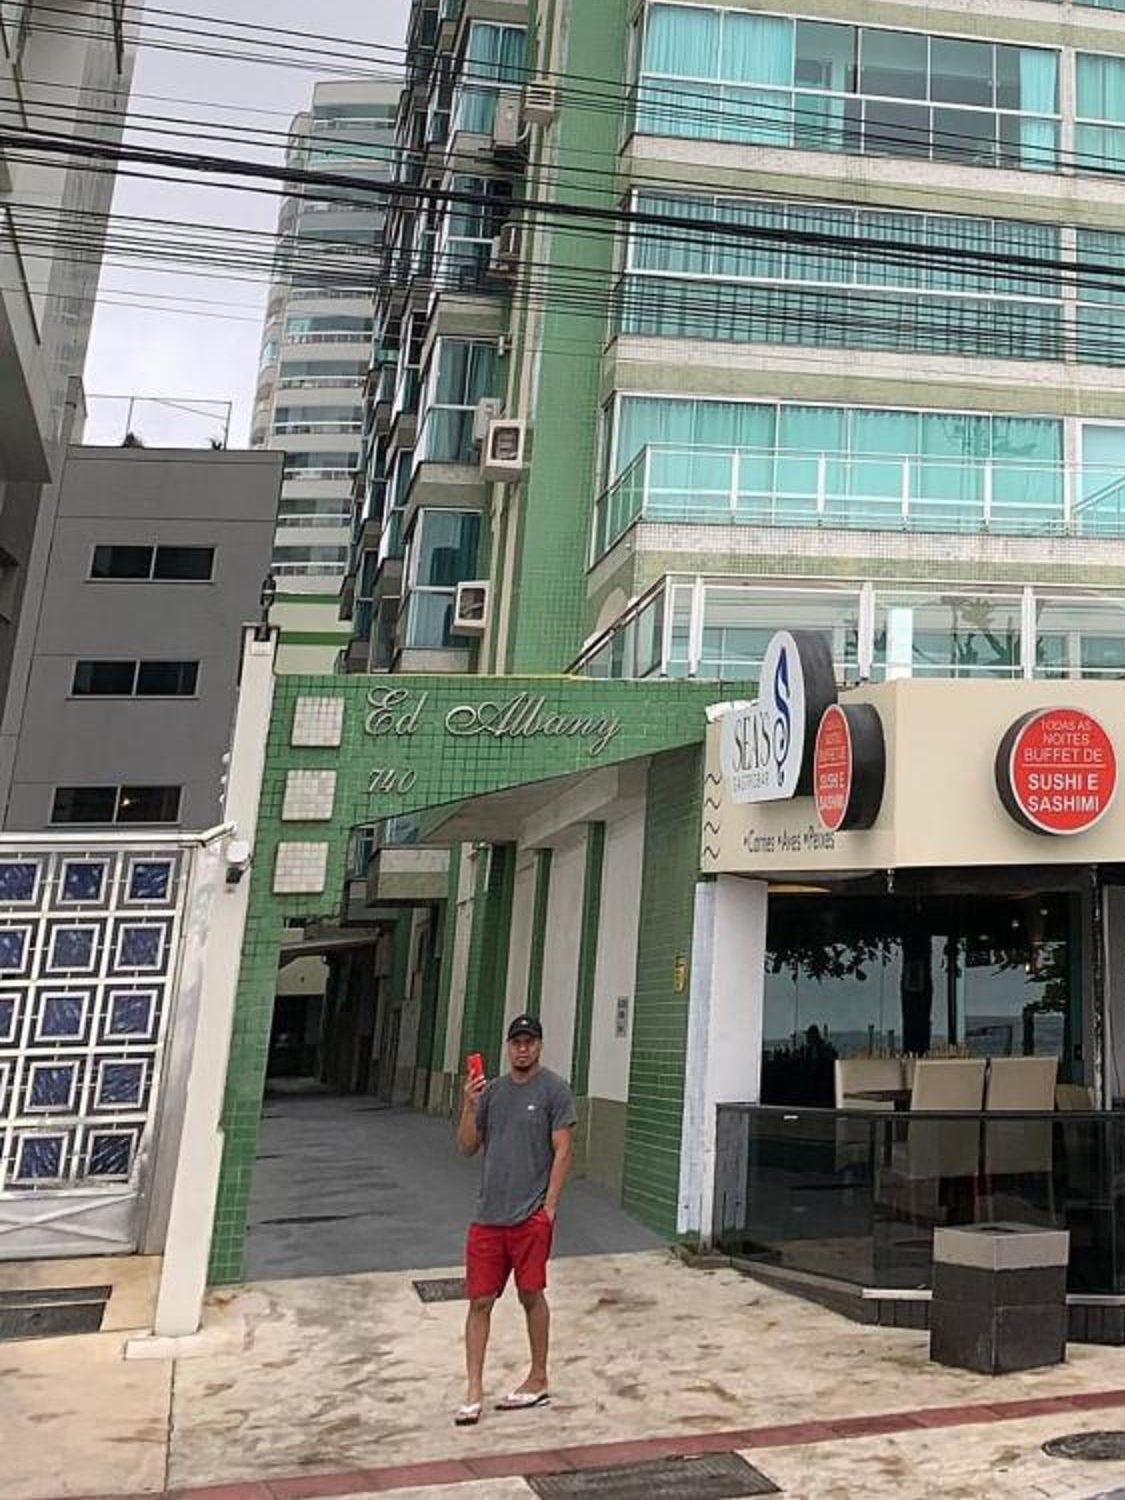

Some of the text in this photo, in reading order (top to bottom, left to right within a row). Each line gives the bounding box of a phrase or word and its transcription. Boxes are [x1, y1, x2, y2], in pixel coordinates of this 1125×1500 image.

[365, 686, 622, 755] Ed Albany
[1041, 720, 1076, 731] TODAS
[1044, 732, 1090, 745] NOITES
[1024, 748, 1103, 762] BUFFET DE
[367, 768, 417, 794] 740
[1027, 773, 1099, 791] SUSHI E
[1028, 796, 1099, 812] SASHIMI
